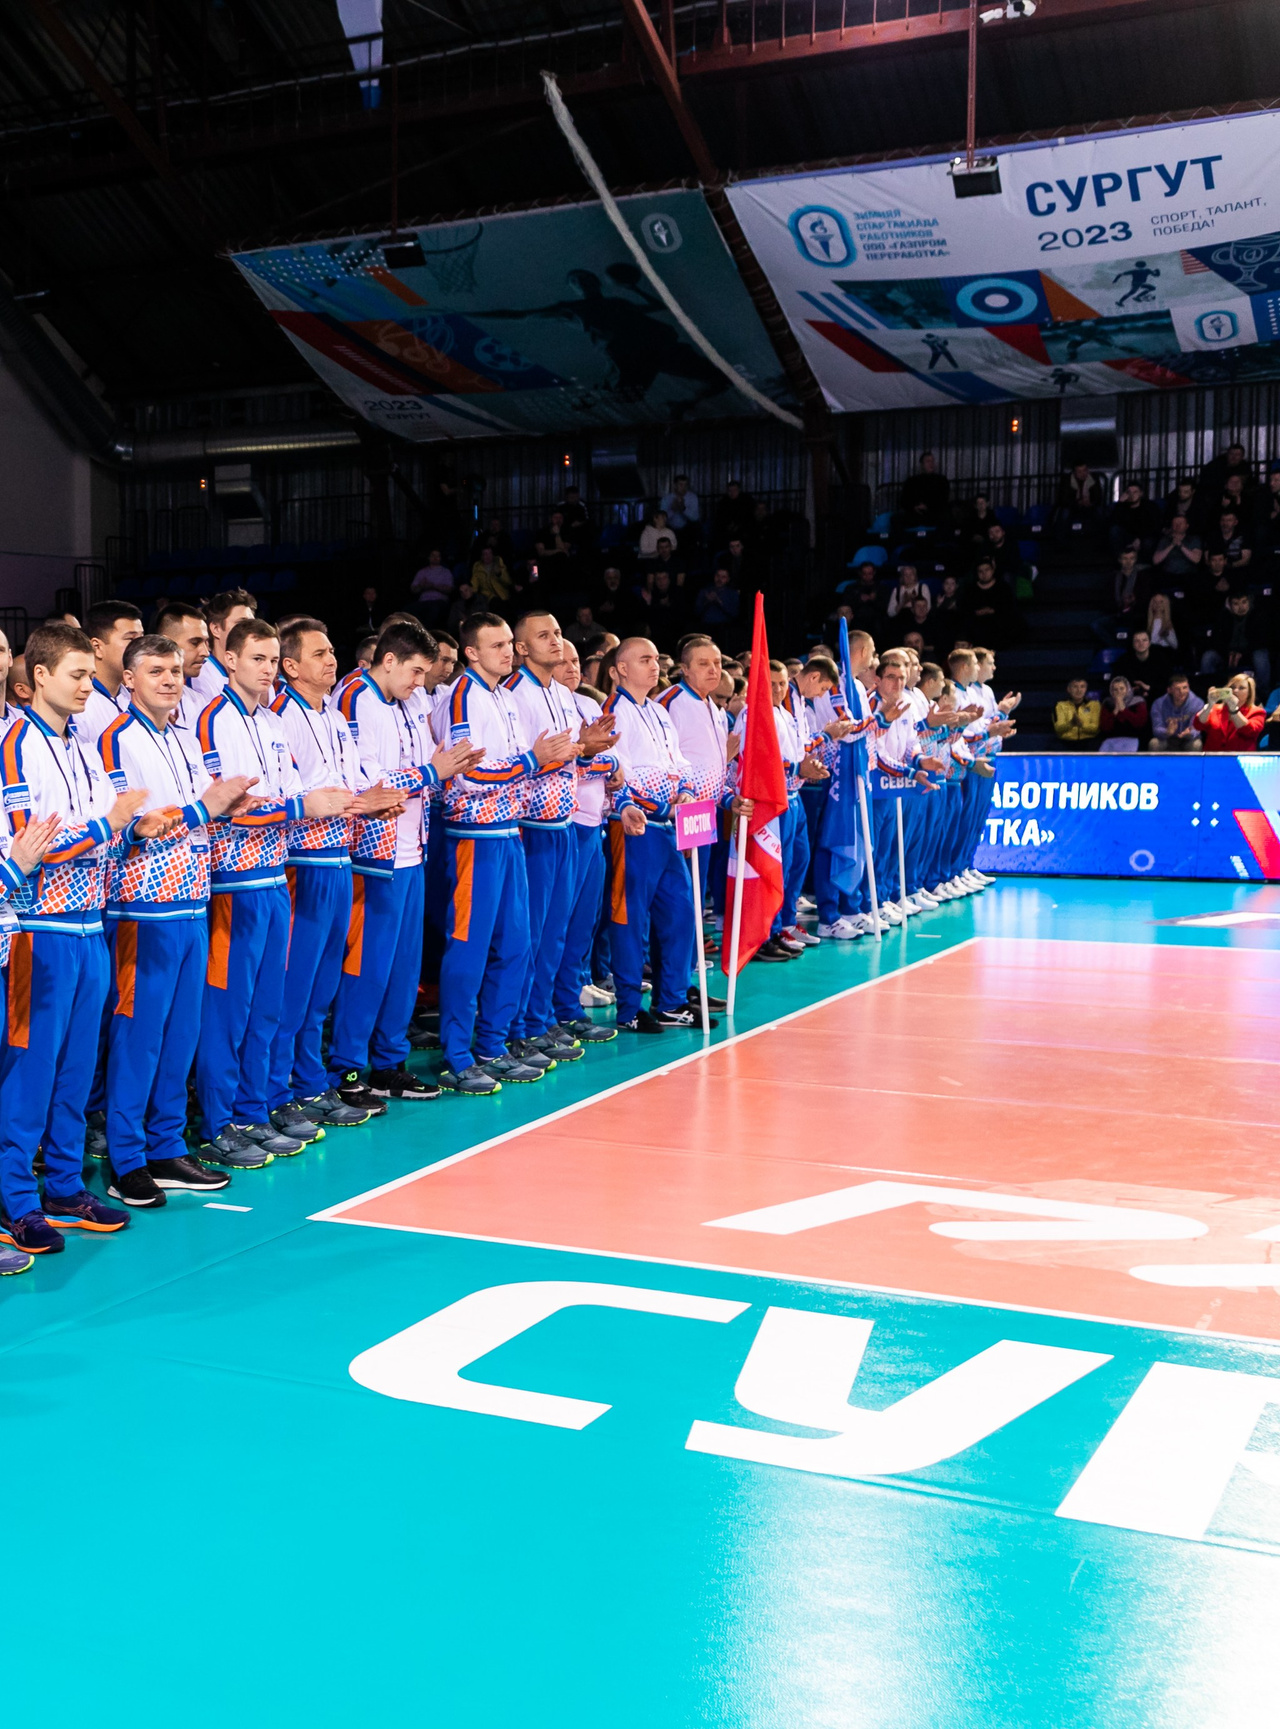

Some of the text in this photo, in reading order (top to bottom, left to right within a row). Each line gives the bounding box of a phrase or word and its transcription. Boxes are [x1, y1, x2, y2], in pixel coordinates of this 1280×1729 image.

[1025, 154, 1223, 217] СУРГУТ
[853, 208, 902, 220] ЗИМНЯЯ
[1150, 196, 1268, 226] СПОРТ, ТАЛАНТ,
[856, 217, 940, 231] СПАРТАКИАДА
[1152, 218, 1216, 237] ПОБЕДА!
[859, 229, 934, 241] РАБОТНИКОВ
[1037, 221, 1133, 252] 2023
[863, 241, 886, 252] ООО
[364, 400, 423, 411] 2023
[683, 812, 712, 836] ВОСТОК
[980, 818, 1056, 847] ТКА»
